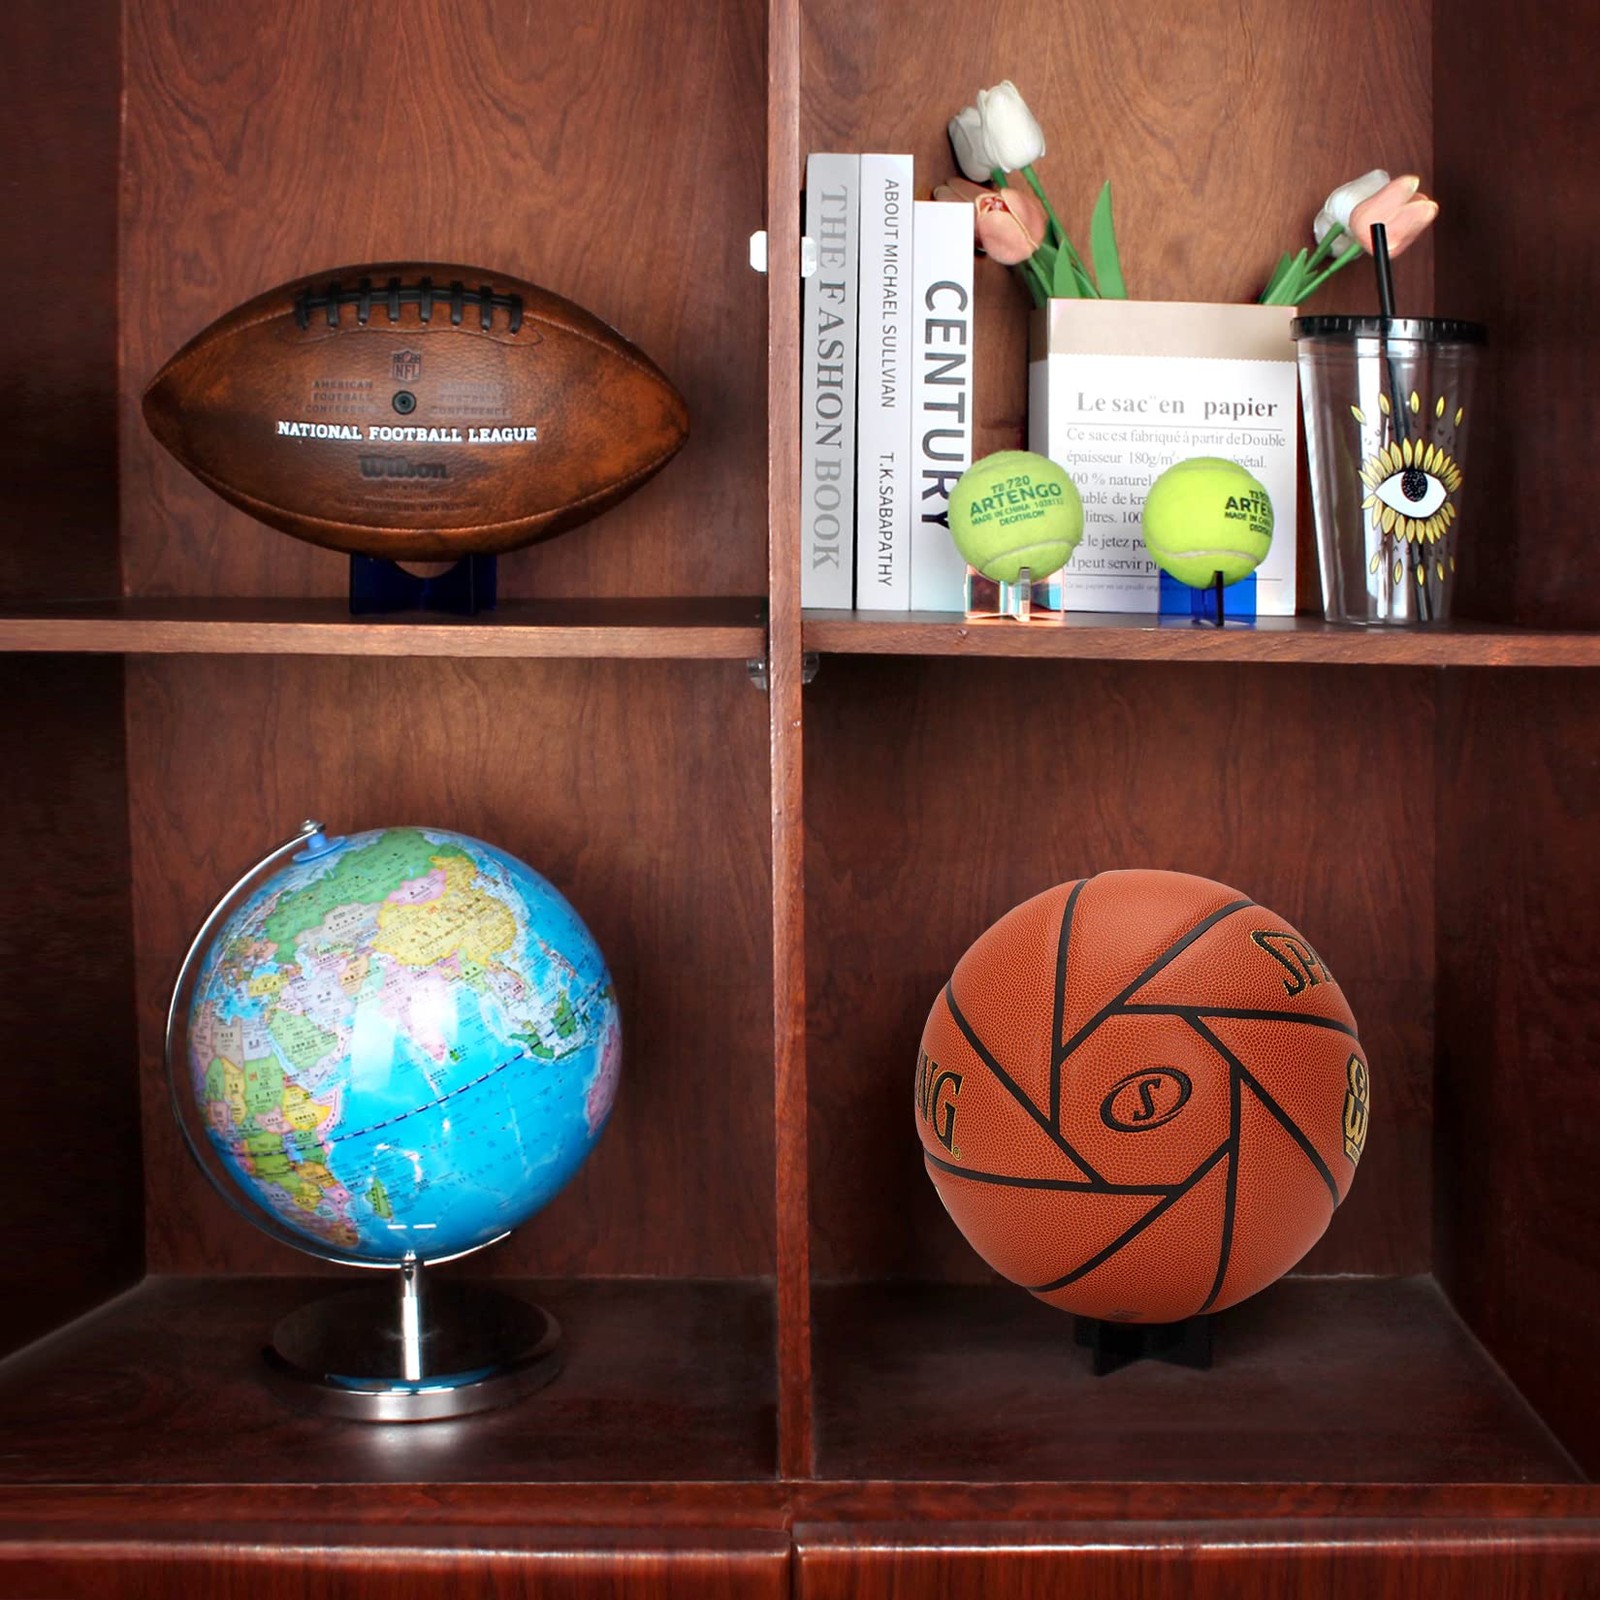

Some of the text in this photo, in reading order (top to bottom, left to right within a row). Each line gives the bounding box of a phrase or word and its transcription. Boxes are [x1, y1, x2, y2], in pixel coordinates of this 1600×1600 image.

[884, 179, 899, 239] ABOUT
[882, 245, 898, 320] MICHAEL
[395, 364, 421, 377] NFL
[881, 325, 897, 408] SULLVIAN
[313, 381, 373, 390] AMERICAN
[813, 185, 847, 570] THE FASHON BOOK
[921, 280, 968, 529] CENTURY
[1077, 392, 1106, 412] Le
[1159, 398, 1185, 414] en
[1203, 397, 1278, 421] papier
[277, 420, 537, 442] NATIONAL FOOTBALL LEAGUE
[1067, 427, 1085, 441] Ce
[1088, 429, 1110, 442] sac
[1110, 431, 1127, 442] est
[1130, 428, 1181, 445] fabriqué
[1192, 431, 1223, 446] partir
[1226, 432, 1240, 445] de
[1241, 432, 1285, 447] Double
[358, 454, 450, 479] Wilson
[1067, 450, 1122, 464] épaisseur
[1007, 475, 1030, 489] 720
[1109, 474, 1152, 486] naturel
[970, 483, 1062, 517] ARTENGO
[1112, 493, 1127, 505] de
[1005, 504, 1031, 515] CHINA
[1085, 510, 1117, 523] litres.
[1088, 534, 1098, 546] le
[1101, 535, 1130, 550] jetez
[1077, 557, 1105, 570] peut
[1107, 557, 1141, 570] servir
[1132, 1077, 1162, 1122] S
